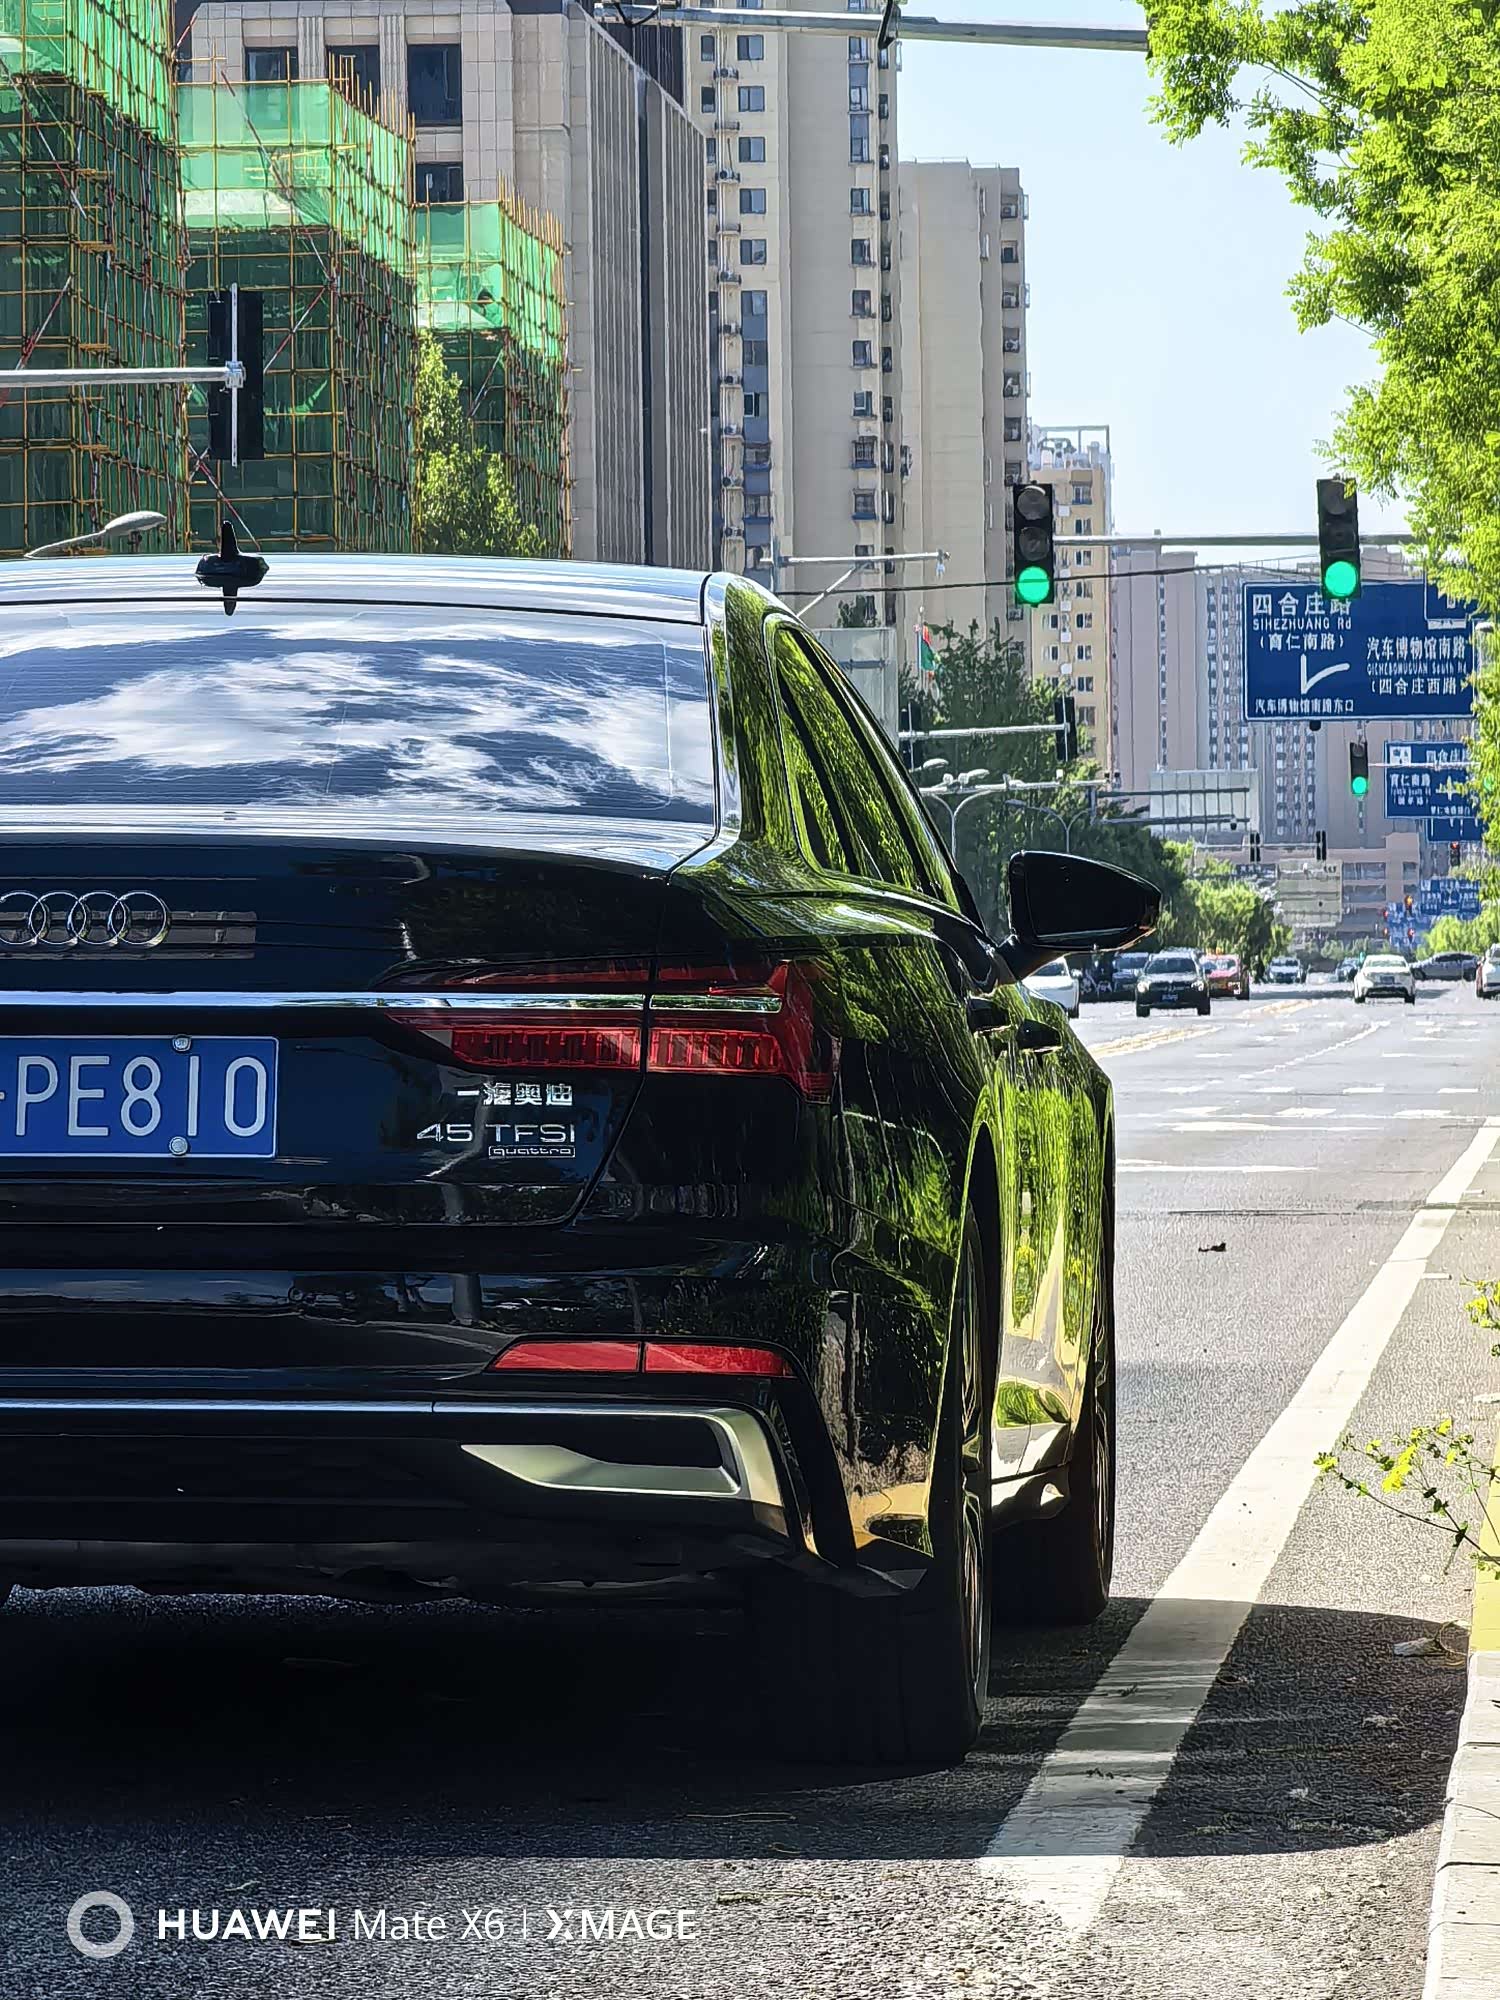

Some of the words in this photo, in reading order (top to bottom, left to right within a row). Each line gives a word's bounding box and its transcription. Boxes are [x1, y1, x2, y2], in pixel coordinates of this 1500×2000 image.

[1252, 592, 1352, 616] 四合庄路
[1253, 617, 1330, 632] SIHEZHUANG
[1337, 617, 1352, 630] Rd
[1366, 635, 1466, 661] 汽车博物馆南路
[416, 1123, 473, 1142] 45
[485, 1123, 575, 1143] TFSI
[492, 1147, 572, 1159] quattro
